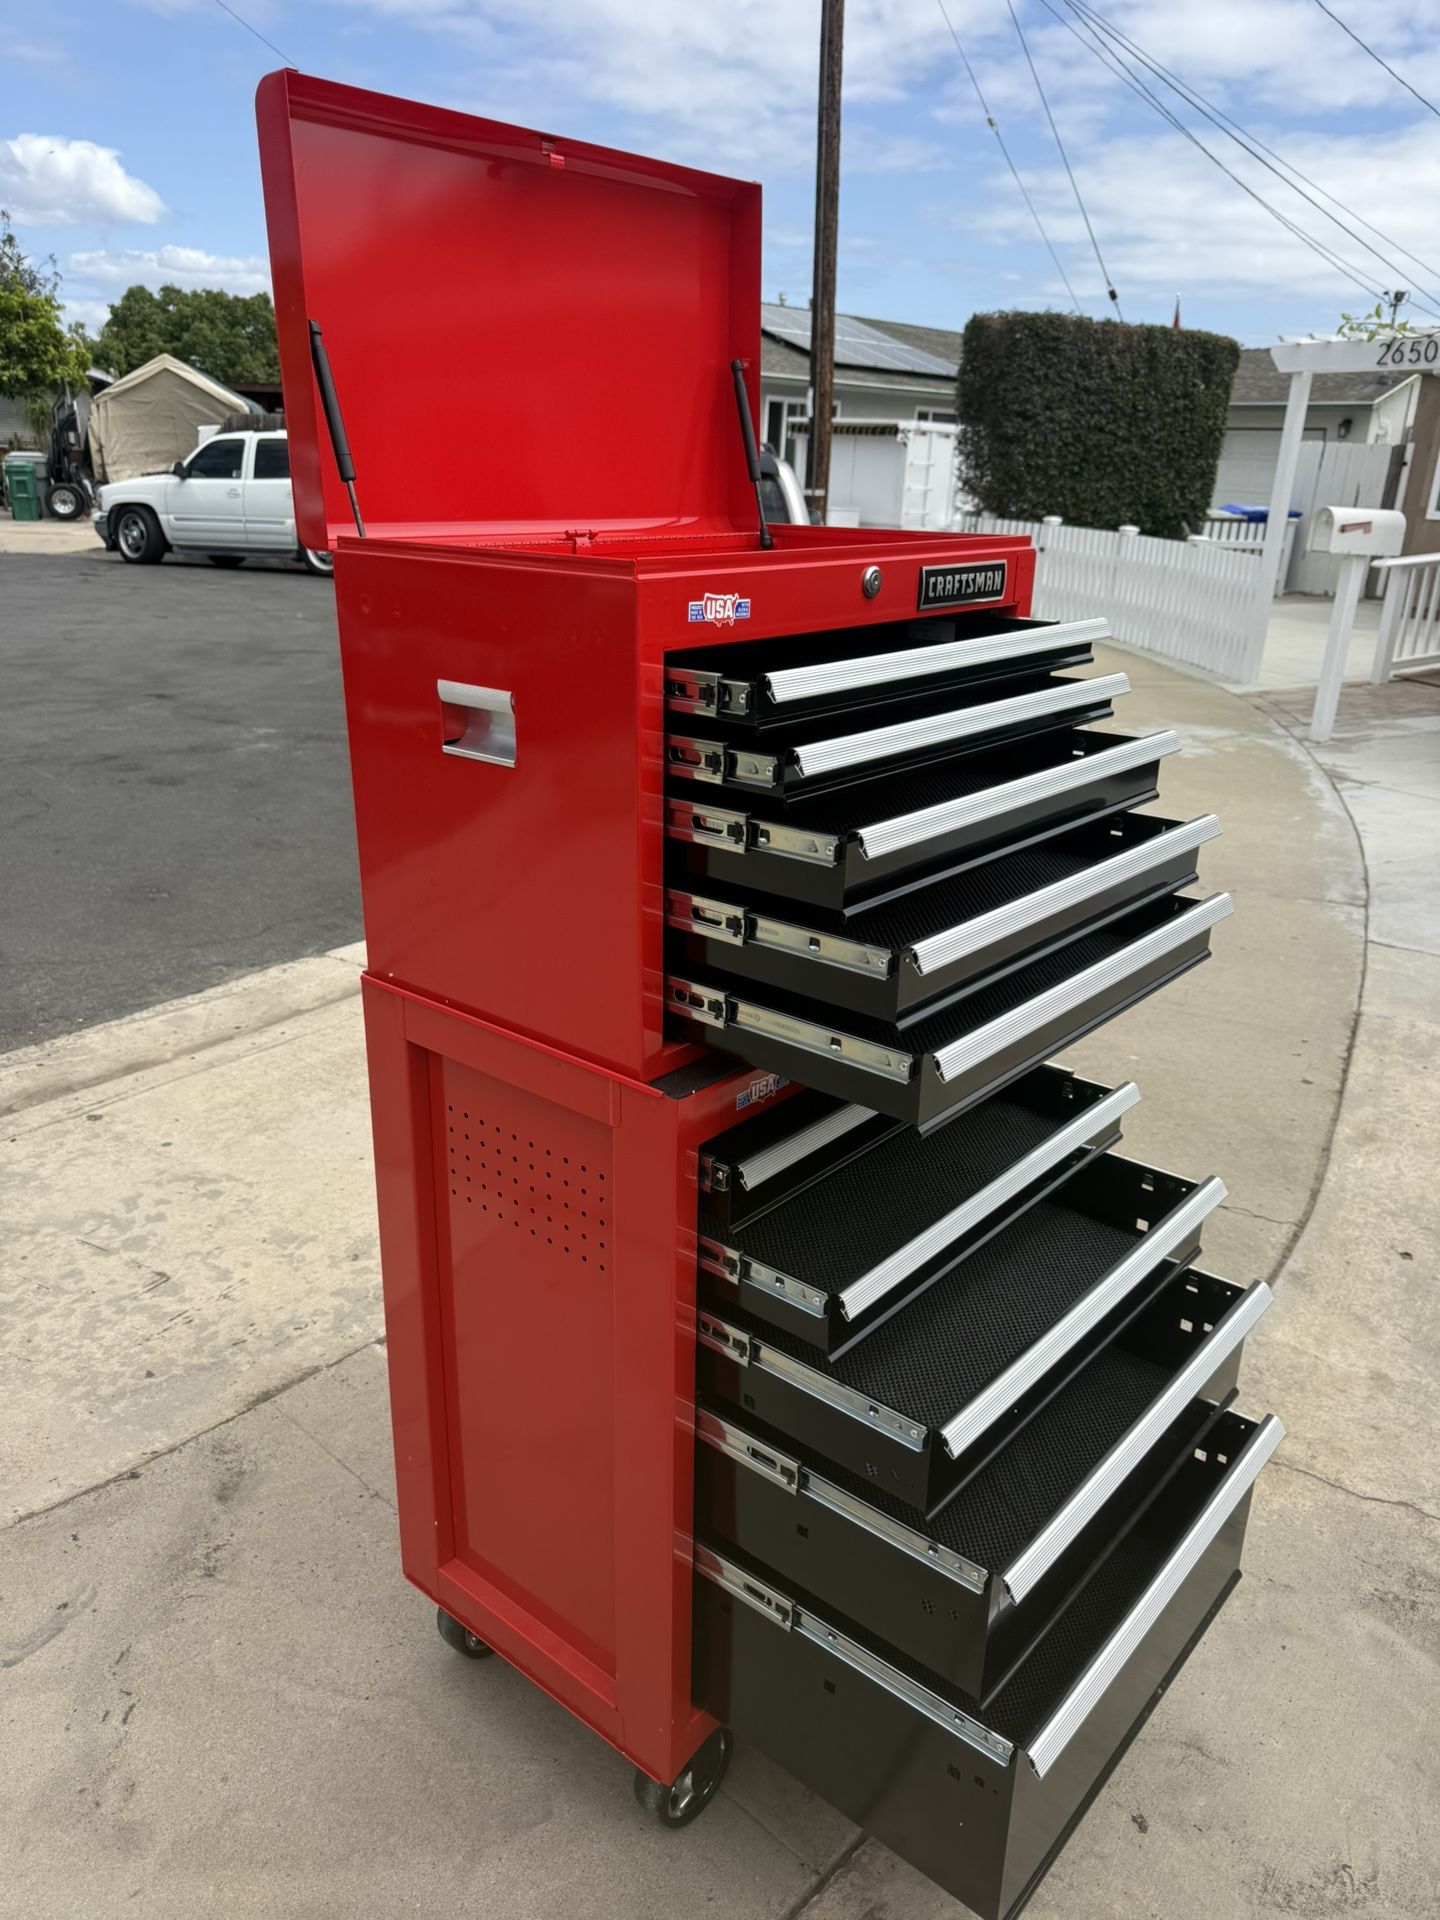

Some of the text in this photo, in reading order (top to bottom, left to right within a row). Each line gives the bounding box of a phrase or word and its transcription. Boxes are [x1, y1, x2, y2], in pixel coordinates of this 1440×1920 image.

[1376, 340, 1439, 365] 2650
[928, 570, 1002, 598] CRAFTSMAN
[706, 599, 733, 619] USA
[751, 1077, 776, 1100] USA
